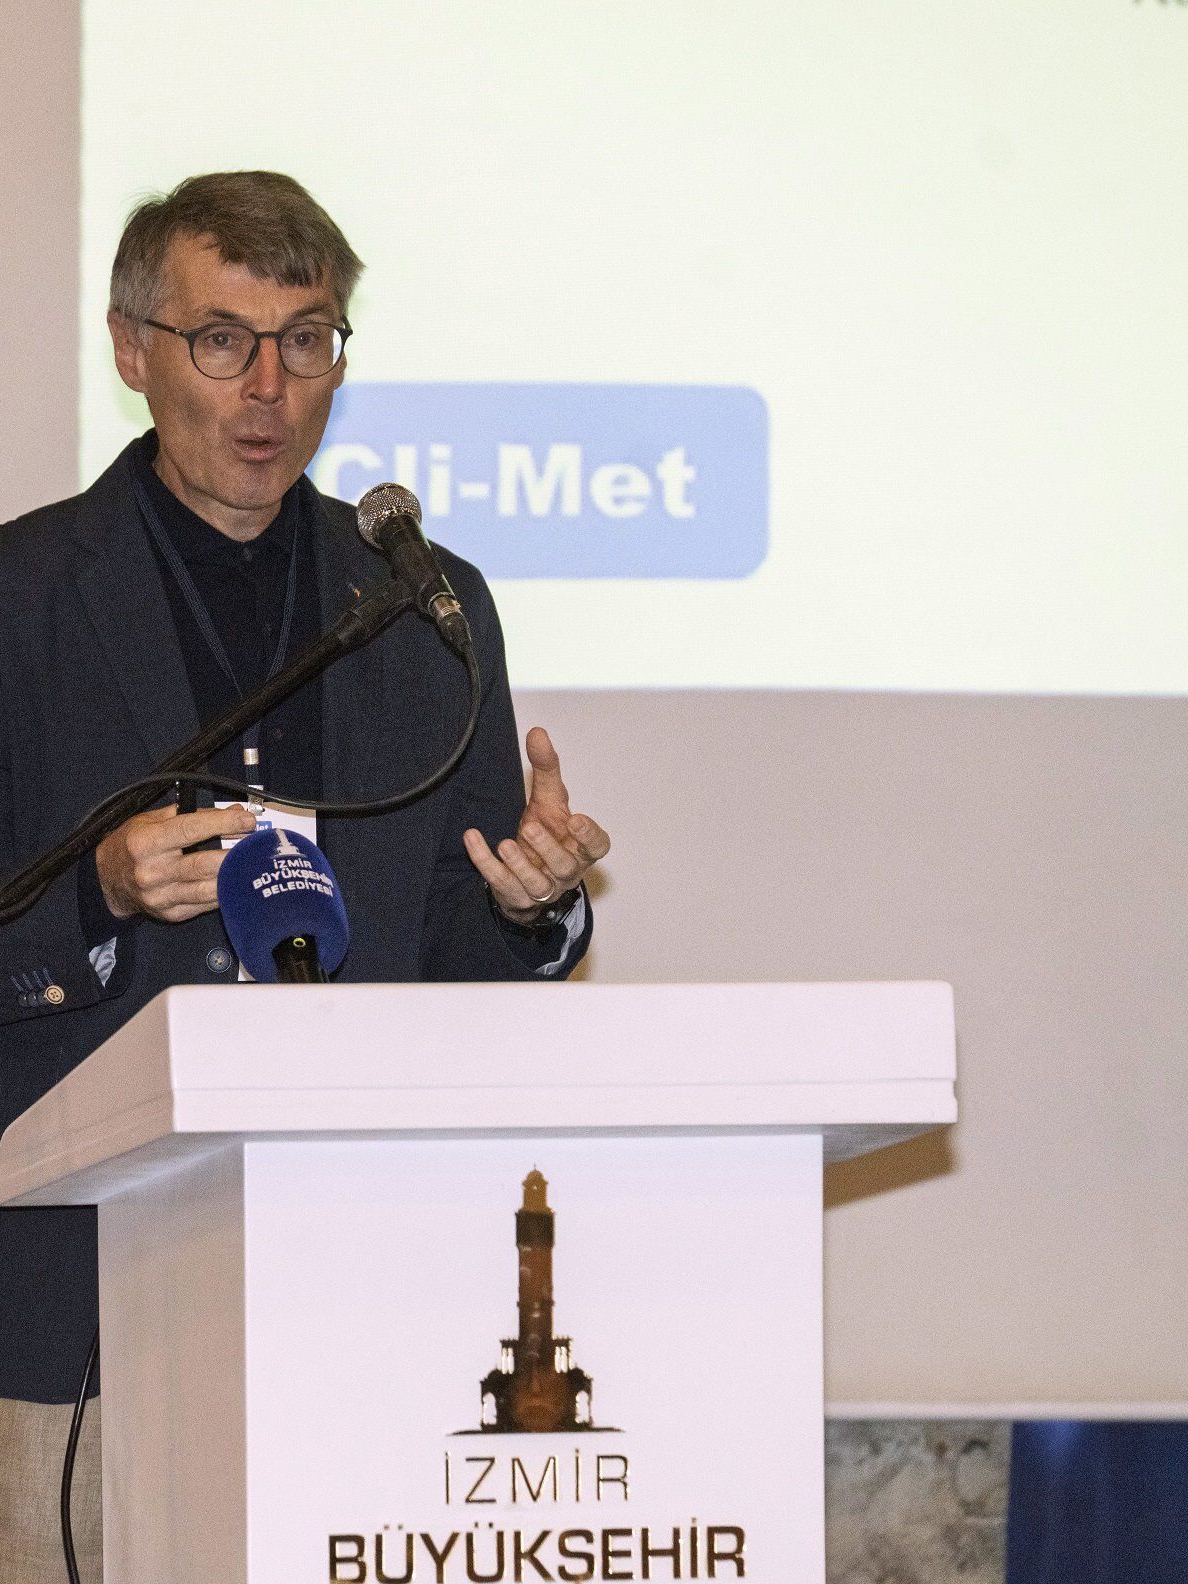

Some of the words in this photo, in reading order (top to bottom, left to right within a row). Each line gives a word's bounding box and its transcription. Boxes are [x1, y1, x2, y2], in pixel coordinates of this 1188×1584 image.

[315, 443, 697, 519] Cli-Met
[262, 880, 333, 898] BELEDİYESİ
[273, 858, 312, 870] İZMİR
[444, 1447, 632, 1505] İZMİR
[328, 1517, 747, 1584] BÜYÜKŞEHİR
